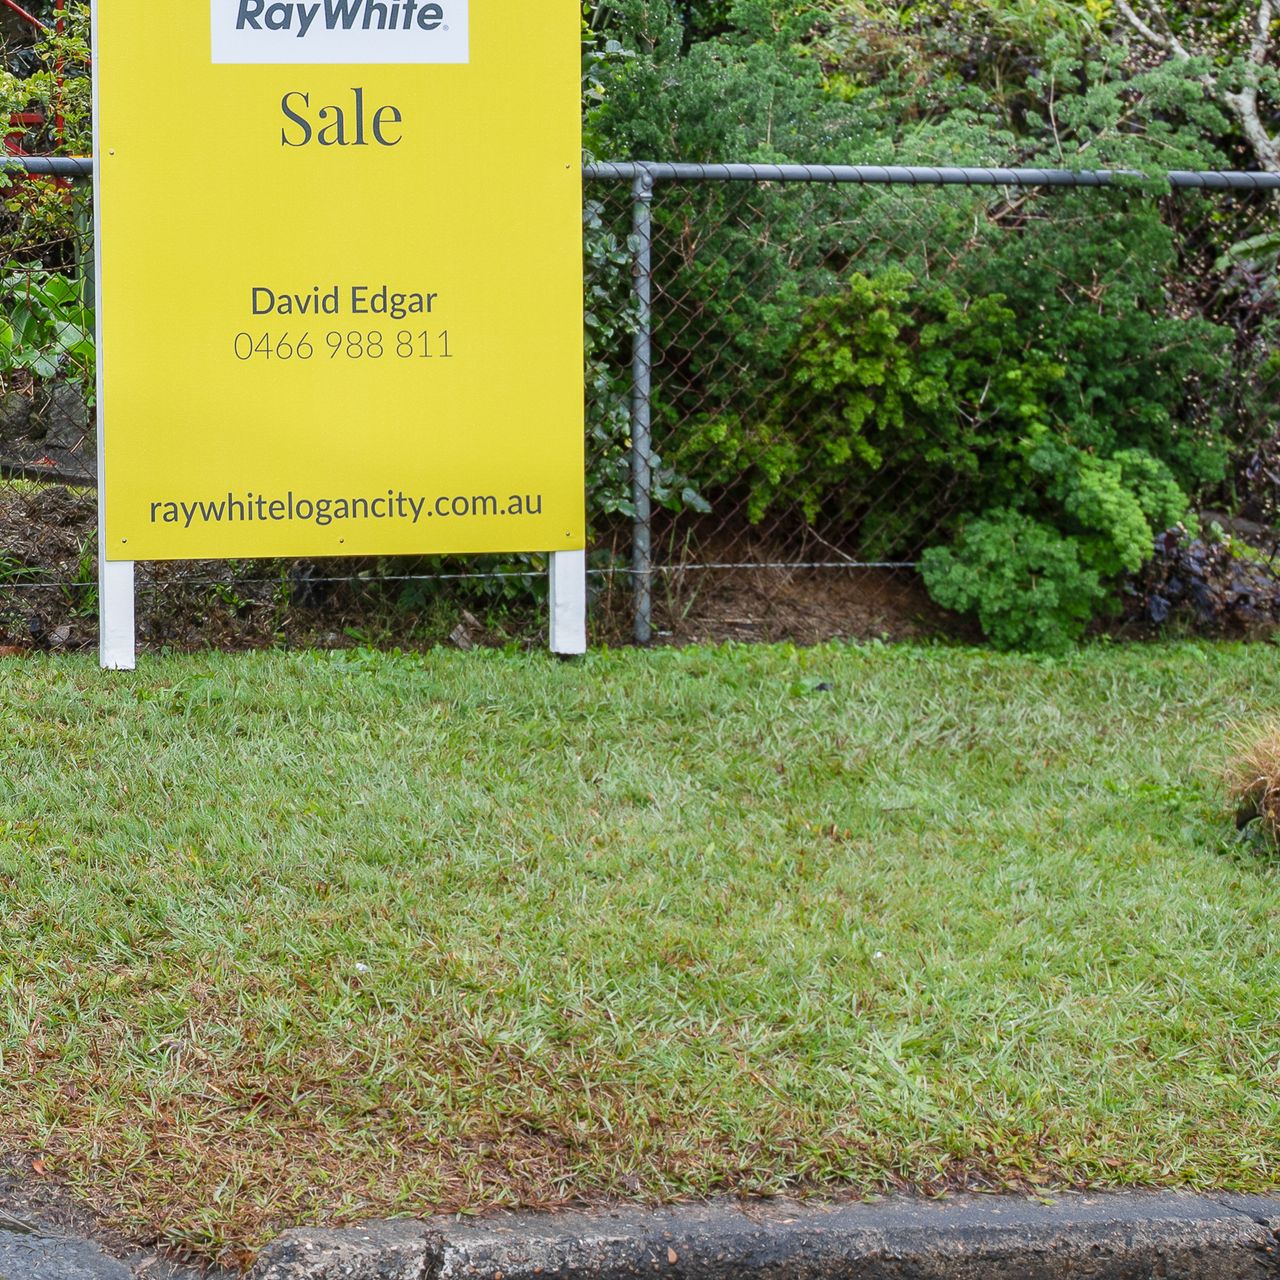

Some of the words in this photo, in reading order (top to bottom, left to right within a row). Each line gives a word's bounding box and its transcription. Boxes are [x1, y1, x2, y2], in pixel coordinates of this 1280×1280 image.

[281, 86, 403, 147] Sale
[251, 286, 339, 317] David
[351, 285, 438, 321] Edgar
[233, 331, 314, 361] 0466
[325, 330, 384, 360] 988
[396, 329, 453, 359] 811
[150, 489, 542, 529] raywhitelogancity.com.au
